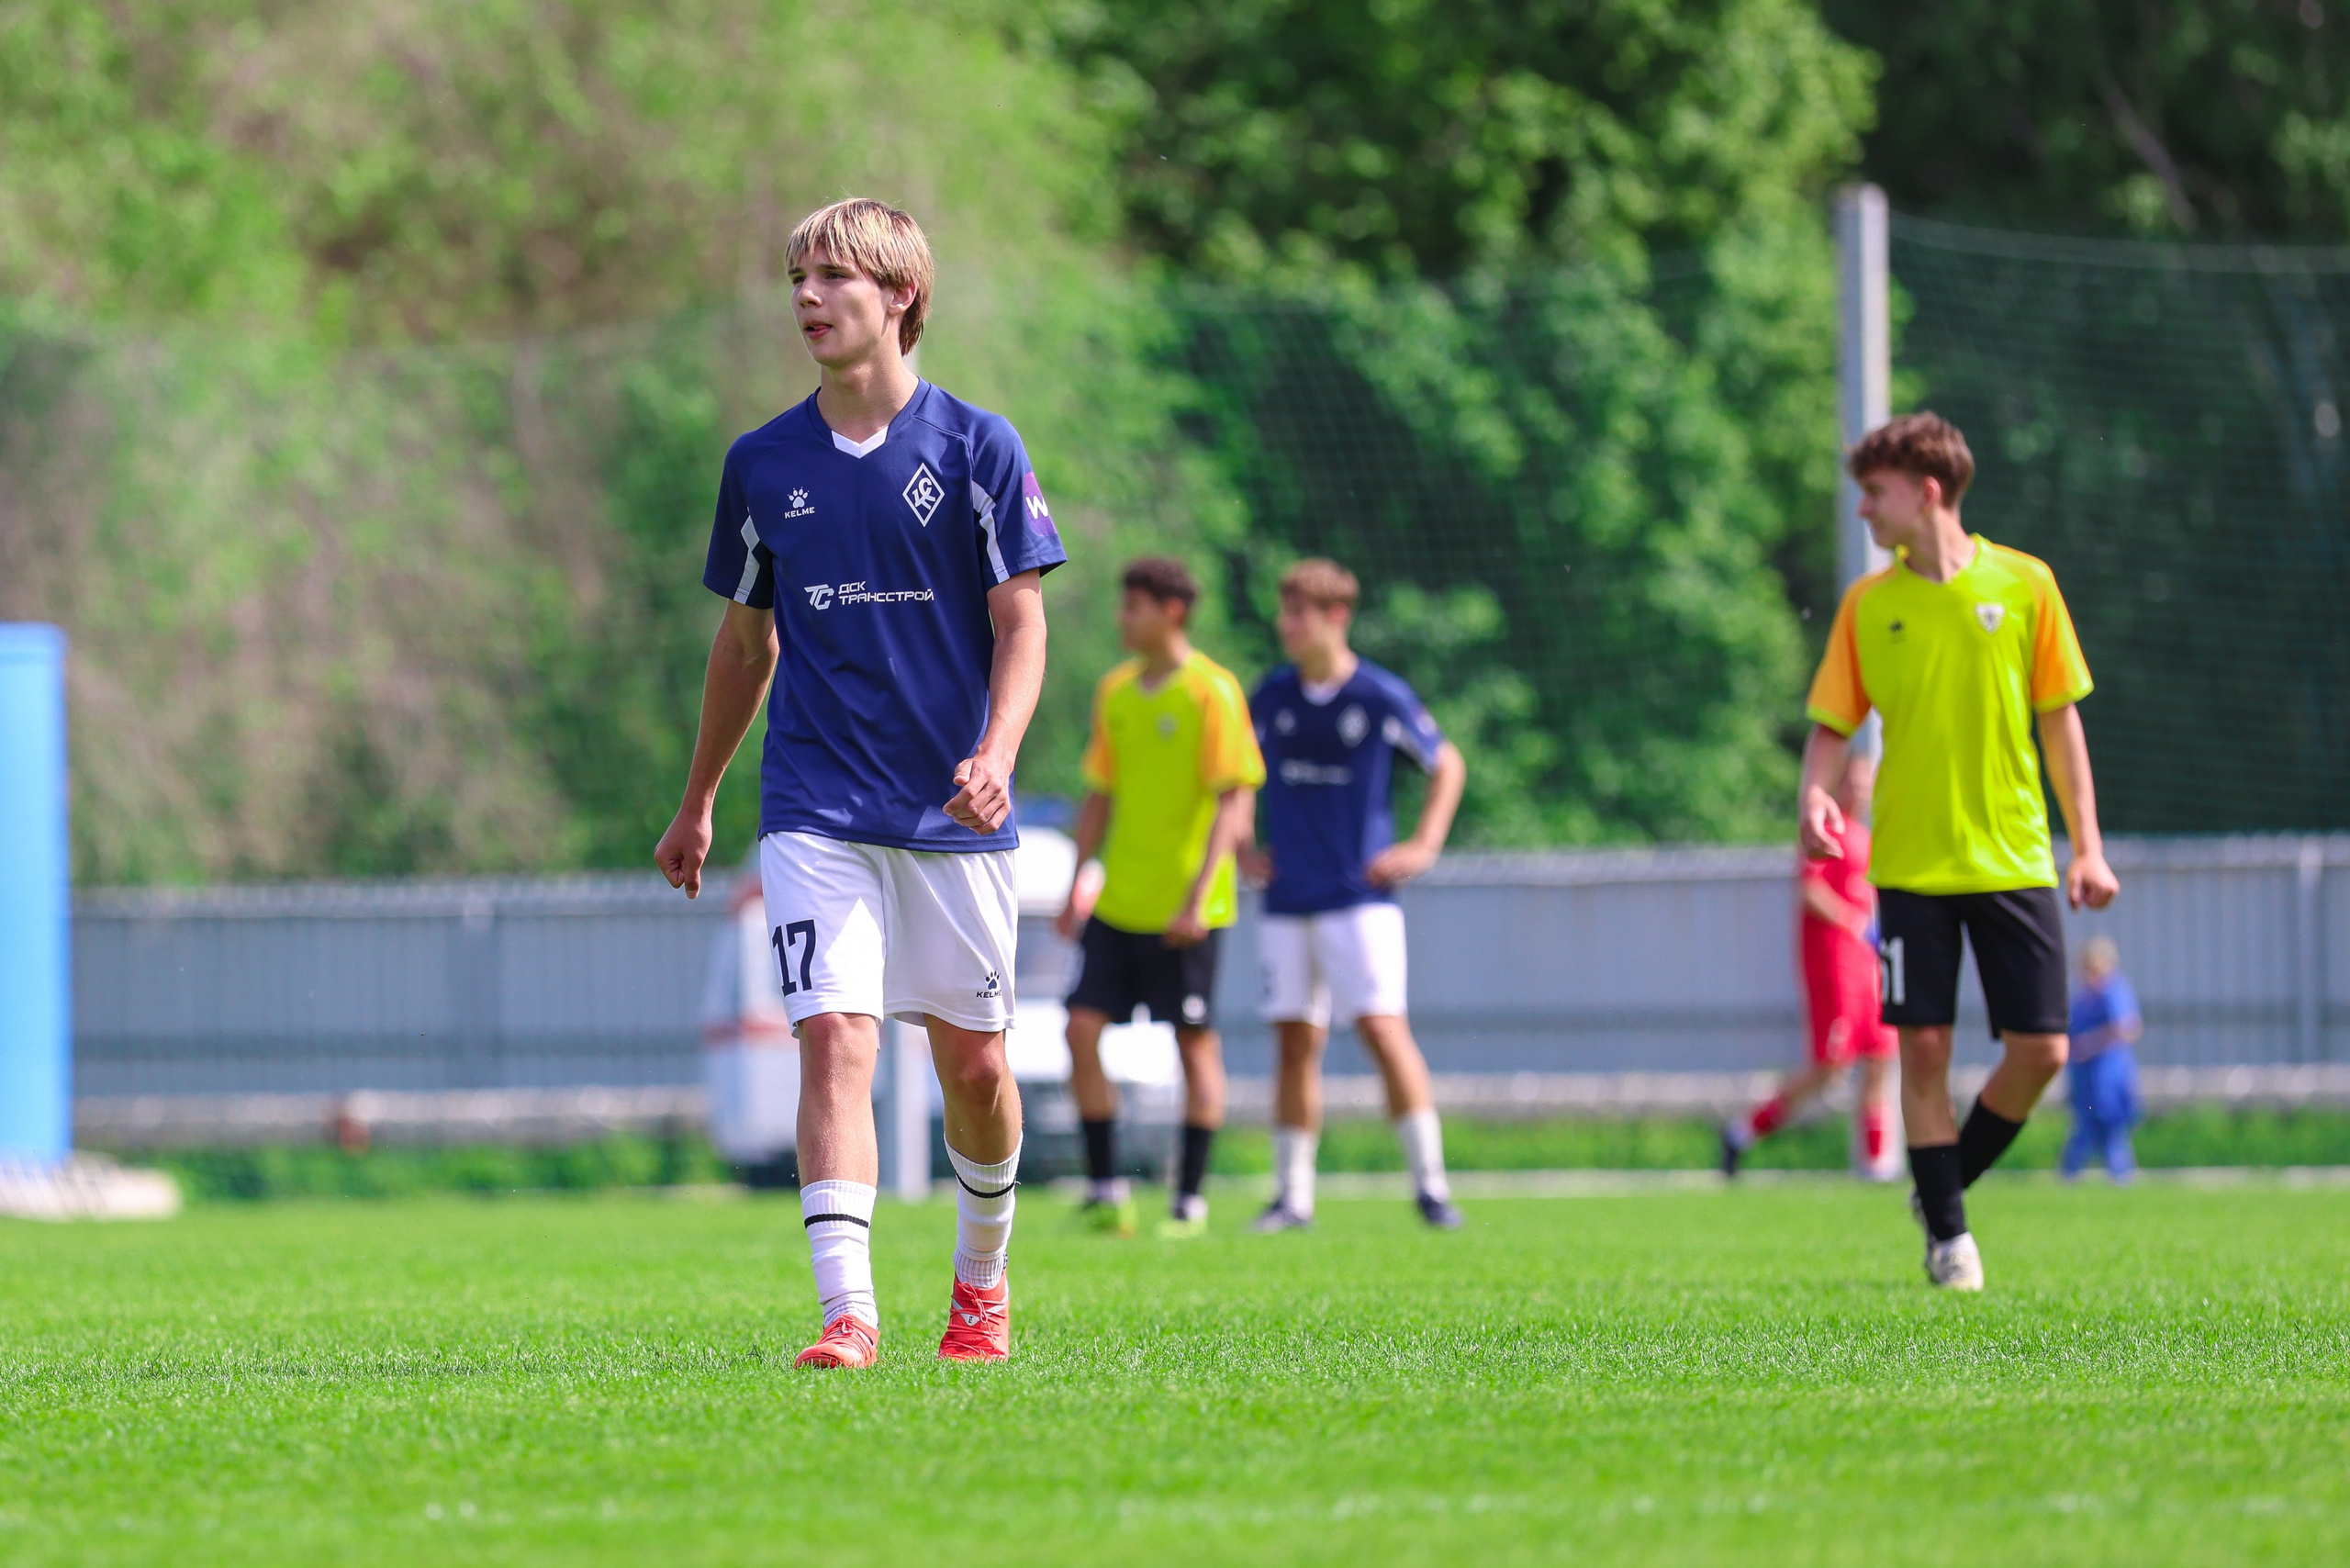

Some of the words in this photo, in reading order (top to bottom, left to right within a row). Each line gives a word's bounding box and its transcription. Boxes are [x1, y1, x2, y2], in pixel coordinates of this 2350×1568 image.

[784, 506, 815, 519] KELME
[838, 581, 866, 595] ДСК
[838, 588, 934, 606] ТРАНССТРОЙ
[772, 918, 816, 997] 17
